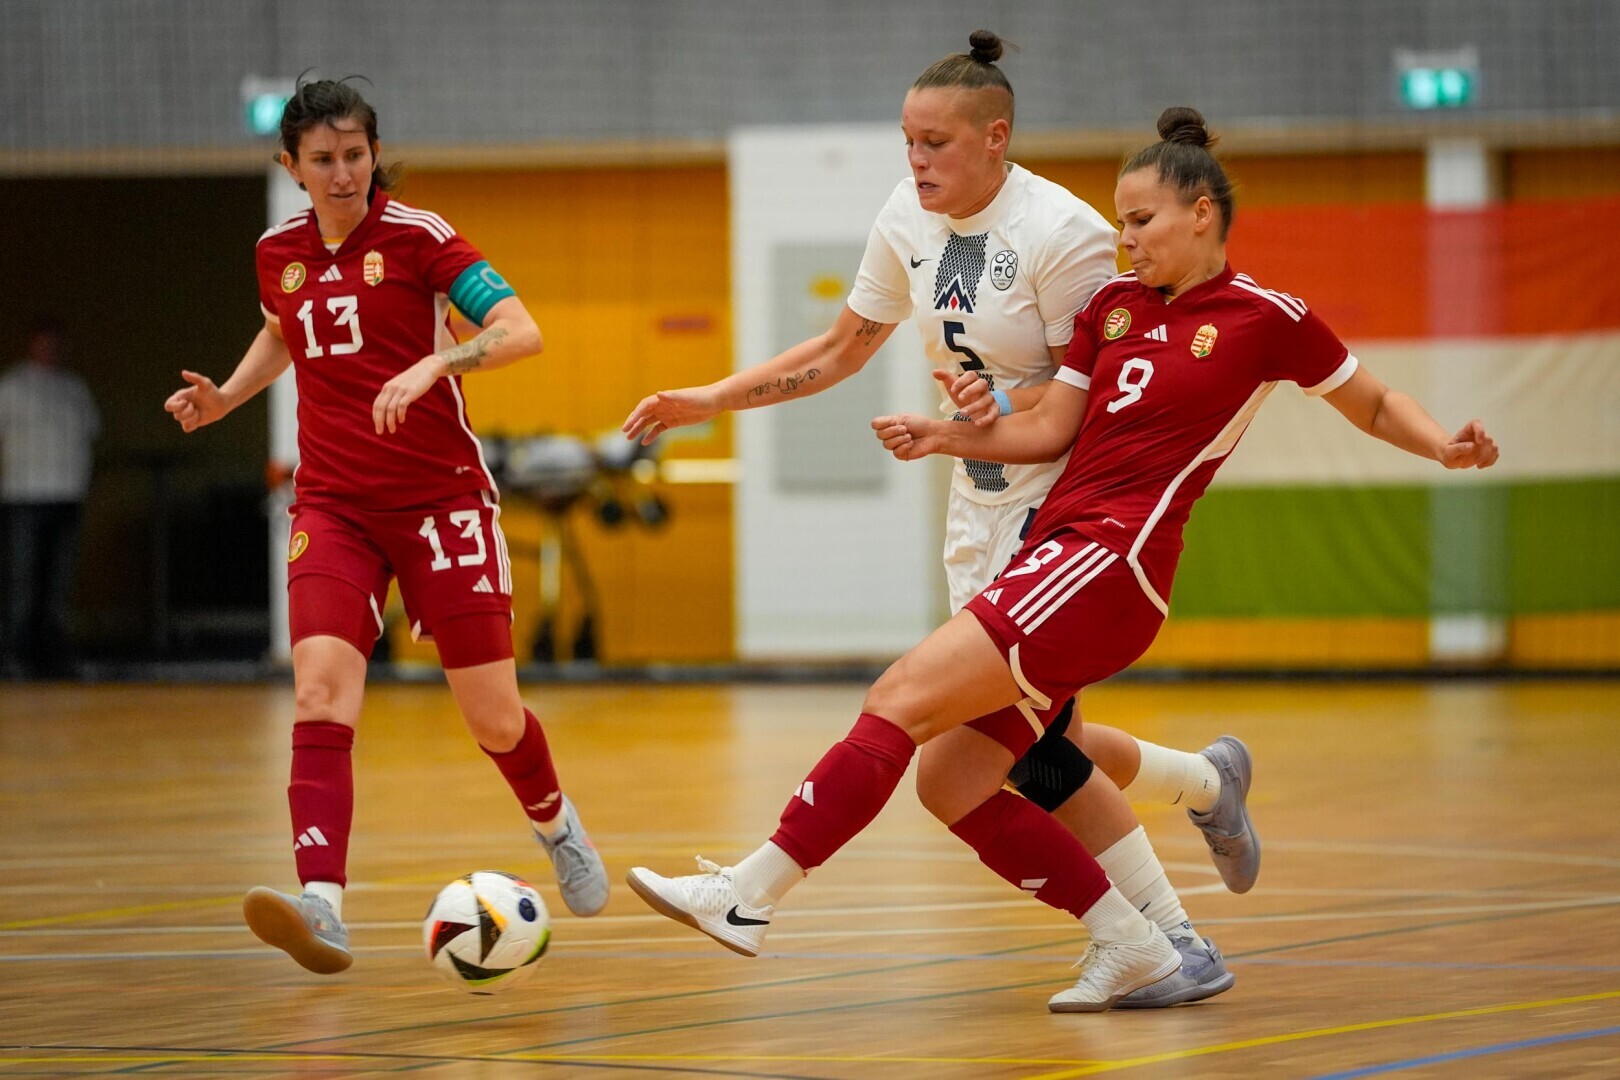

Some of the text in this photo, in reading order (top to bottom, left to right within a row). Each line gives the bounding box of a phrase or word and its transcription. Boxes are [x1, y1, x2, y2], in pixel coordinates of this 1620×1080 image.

[297, 295, 364, 359] 13
[943, 320, 985, 372] 5
[1106, 357, 1155, 414] 9
[418, 509, 488, 571] 13
[1004, 540, 1064, 579] 9
